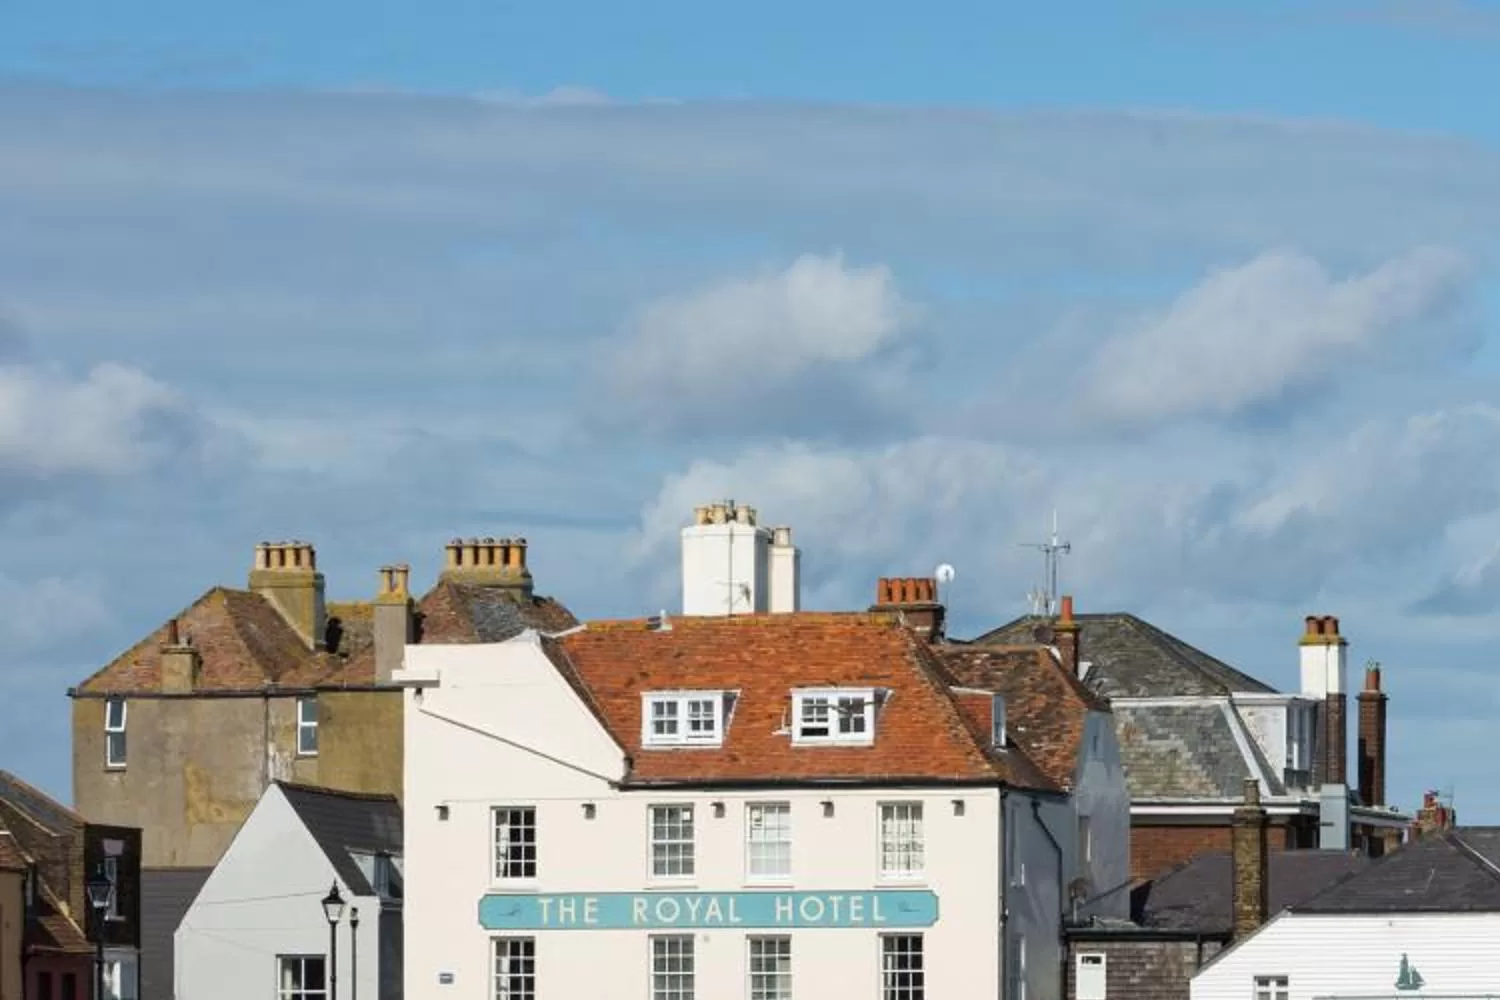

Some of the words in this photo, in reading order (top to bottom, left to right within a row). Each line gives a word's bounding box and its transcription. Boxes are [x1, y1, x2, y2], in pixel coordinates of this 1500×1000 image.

[538, 897, 599, 924] THE
[633, 896, 743, 923] ROYAL
[775, 895, 887, 922] HOTEL
